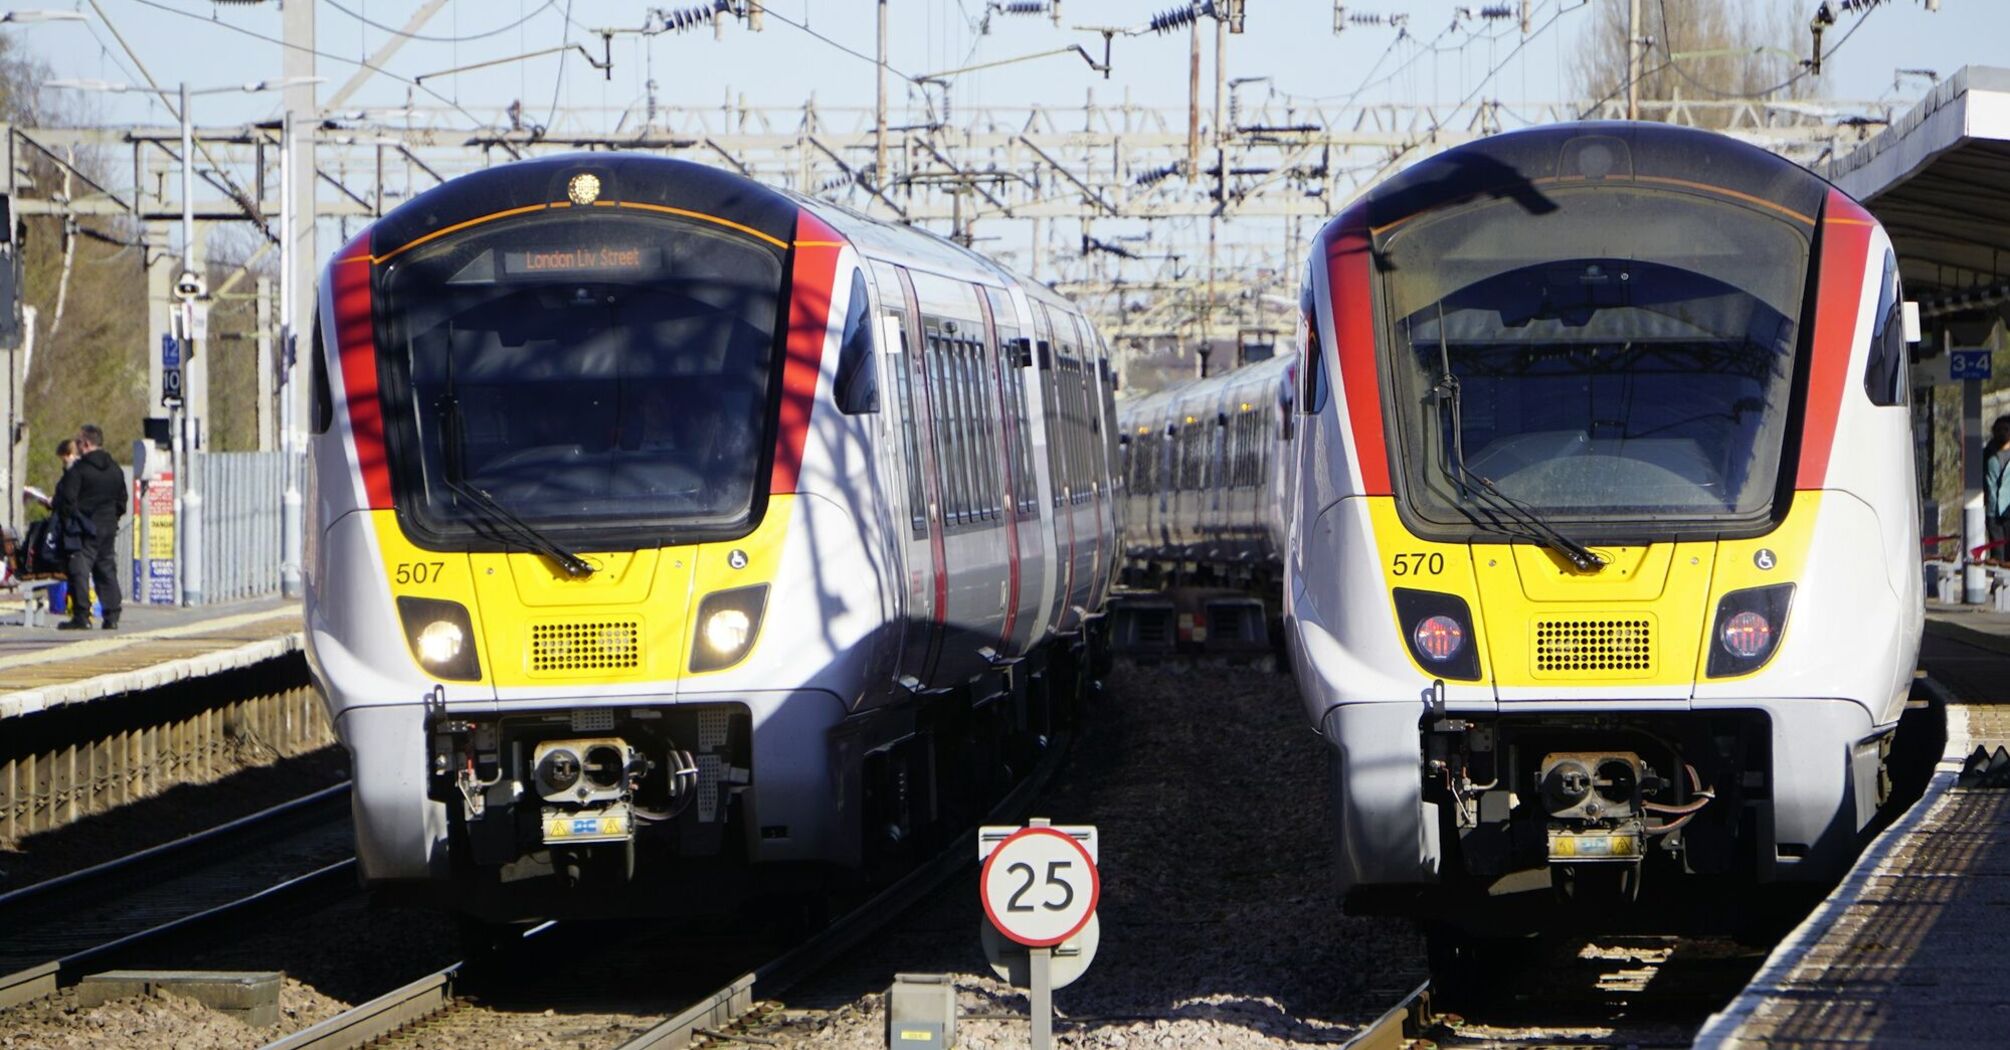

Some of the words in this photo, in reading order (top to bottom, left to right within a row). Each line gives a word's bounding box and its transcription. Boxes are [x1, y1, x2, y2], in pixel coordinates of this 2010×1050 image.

[527, 251, 574, 269] London
[577, 249, 596, 267] Liv
[600, 247, 639, 266] Street
[164, 340, 178, 357] 12
[164, 372, 179, 390] 10
[396, 562, 445, 585] 507
[1393, 553, 1444, 576] 570
[1006, 861, 1074, 912] 25
